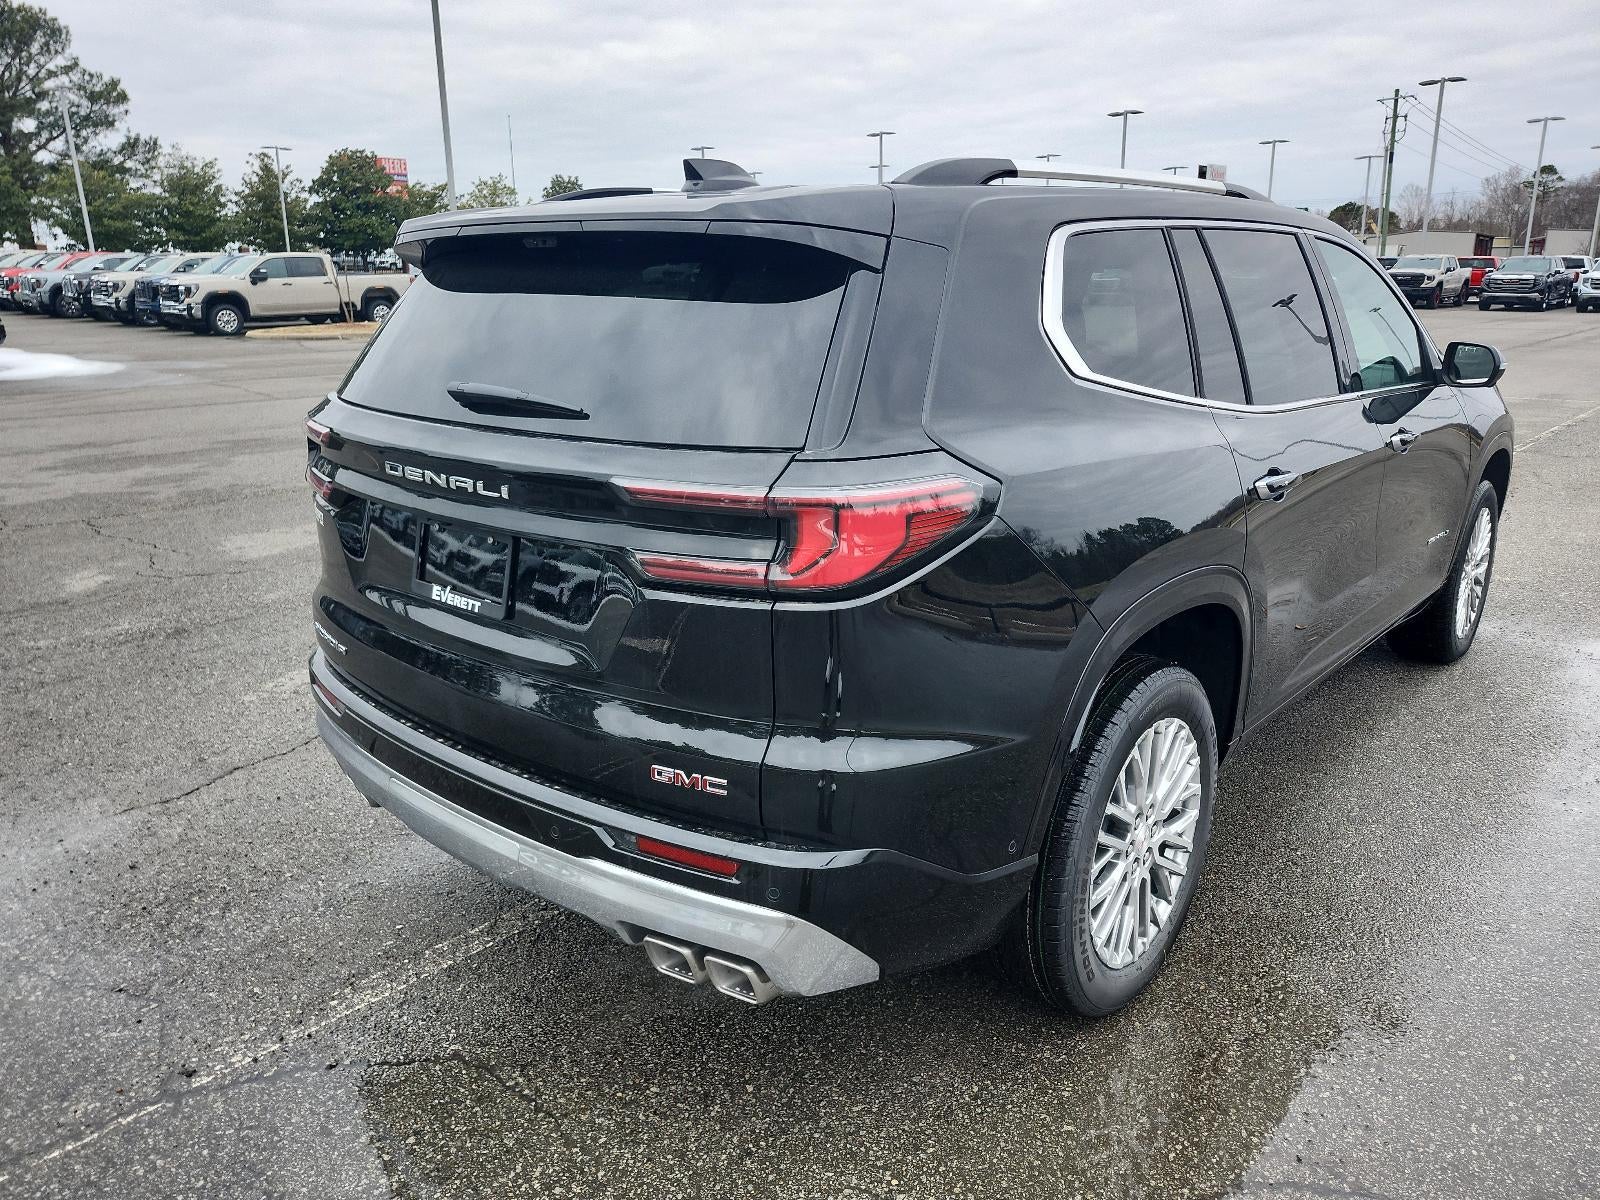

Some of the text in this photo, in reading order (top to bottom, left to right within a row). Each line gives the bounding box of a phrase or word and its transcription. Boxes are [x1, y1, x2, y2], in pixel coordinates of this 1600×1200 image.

[385, 461, 509, 499] DENALI
[431, 584, 481, 612] EVERETT
[650, 764, 727, 795] GMC
